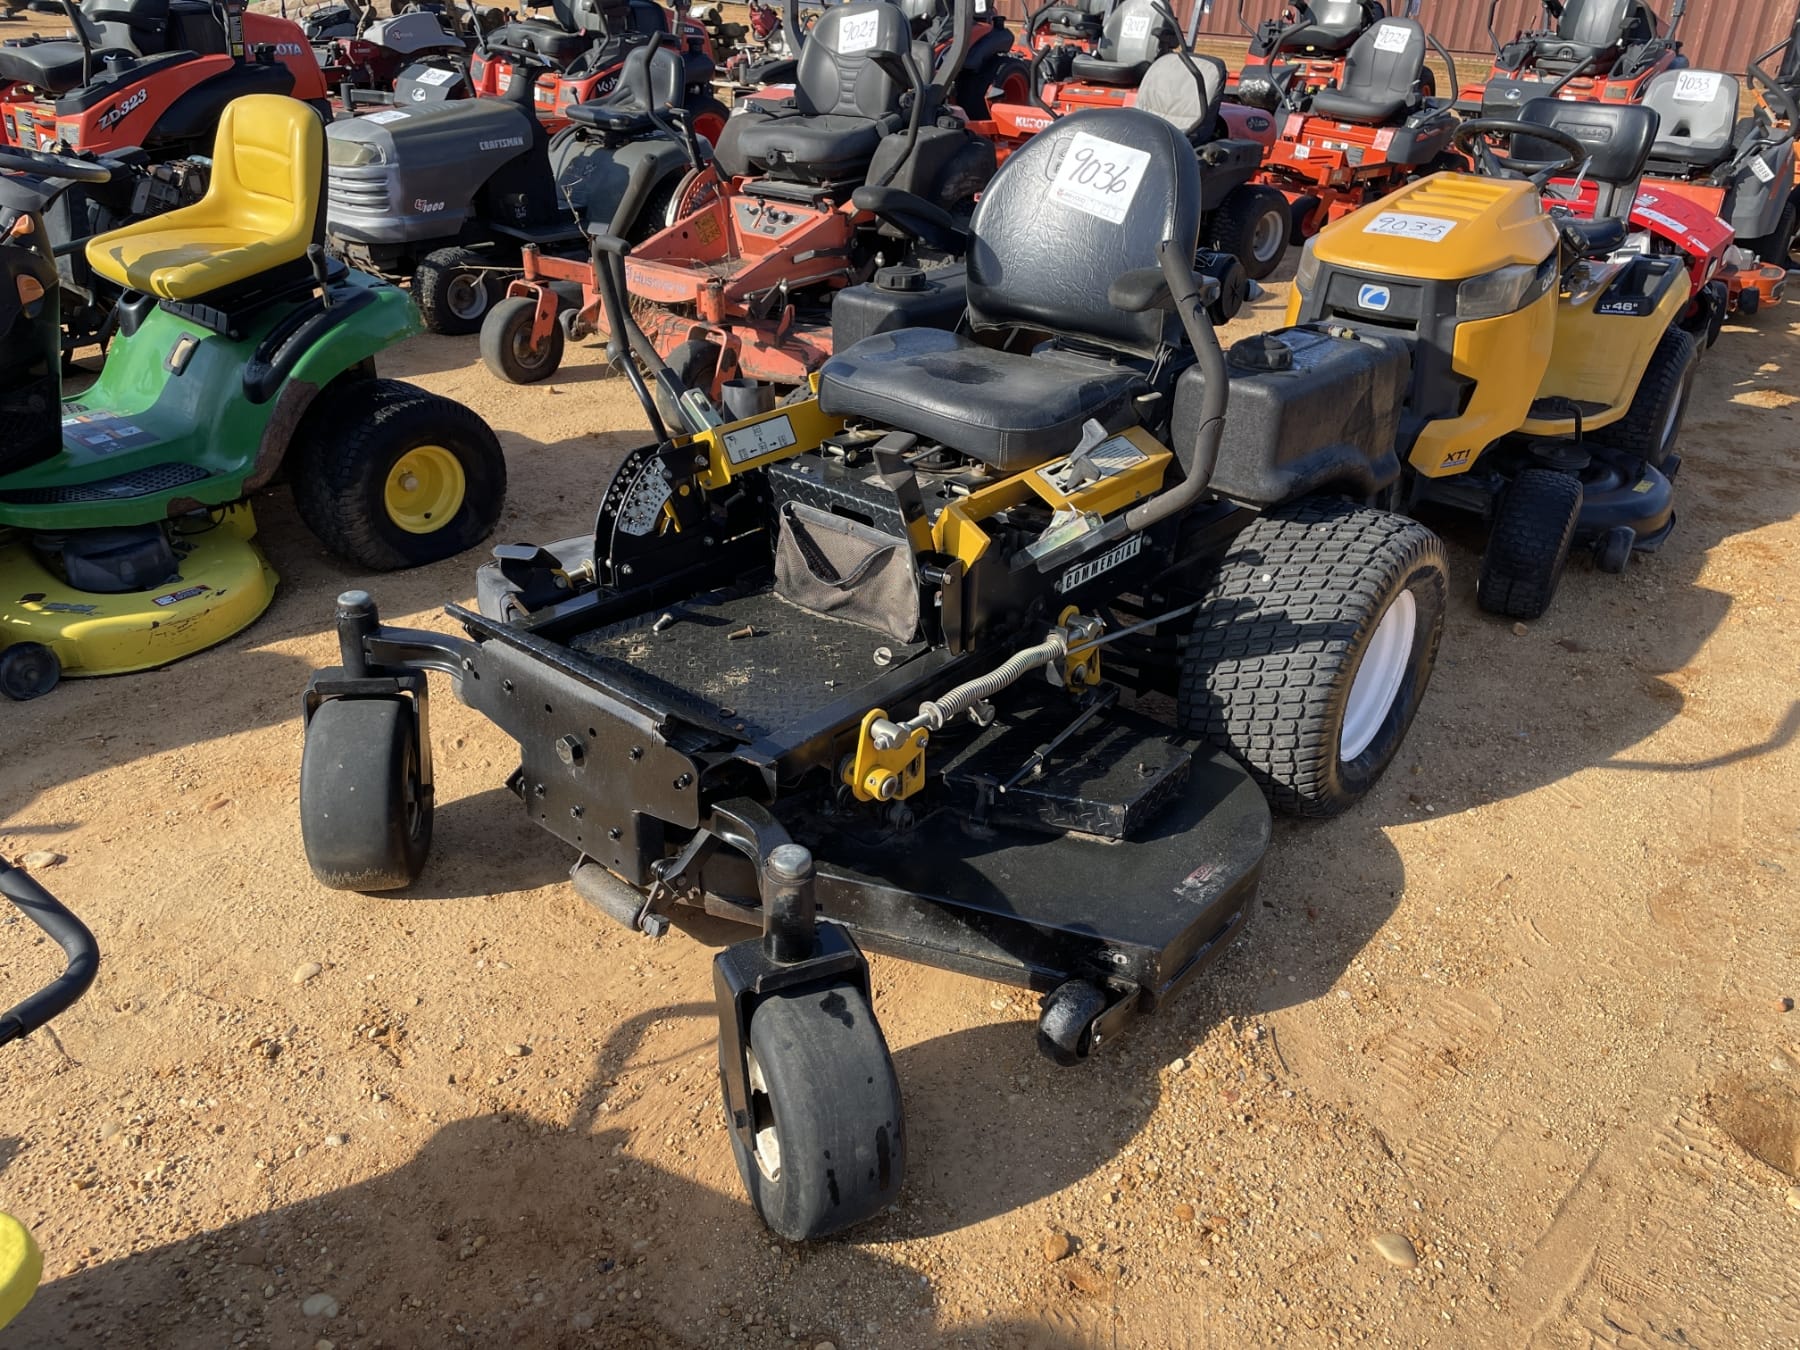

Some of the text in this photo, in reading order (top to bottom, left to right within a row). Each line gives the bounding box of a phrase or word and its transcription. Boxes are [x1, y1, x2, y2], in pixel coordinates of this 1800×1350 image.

[843, 20, 877, 41] 9027
[1679, 74, 1710, 91] 9033
[98, 88, 148, 130] ZD323
[479, 136, 525, 151] CRAFTSMAN
[1068, 147, 1131, 195] 9036
[1379, 216, 1446, 236] 9035
[1066, 541, 1138, 589] COMMERCIAL
